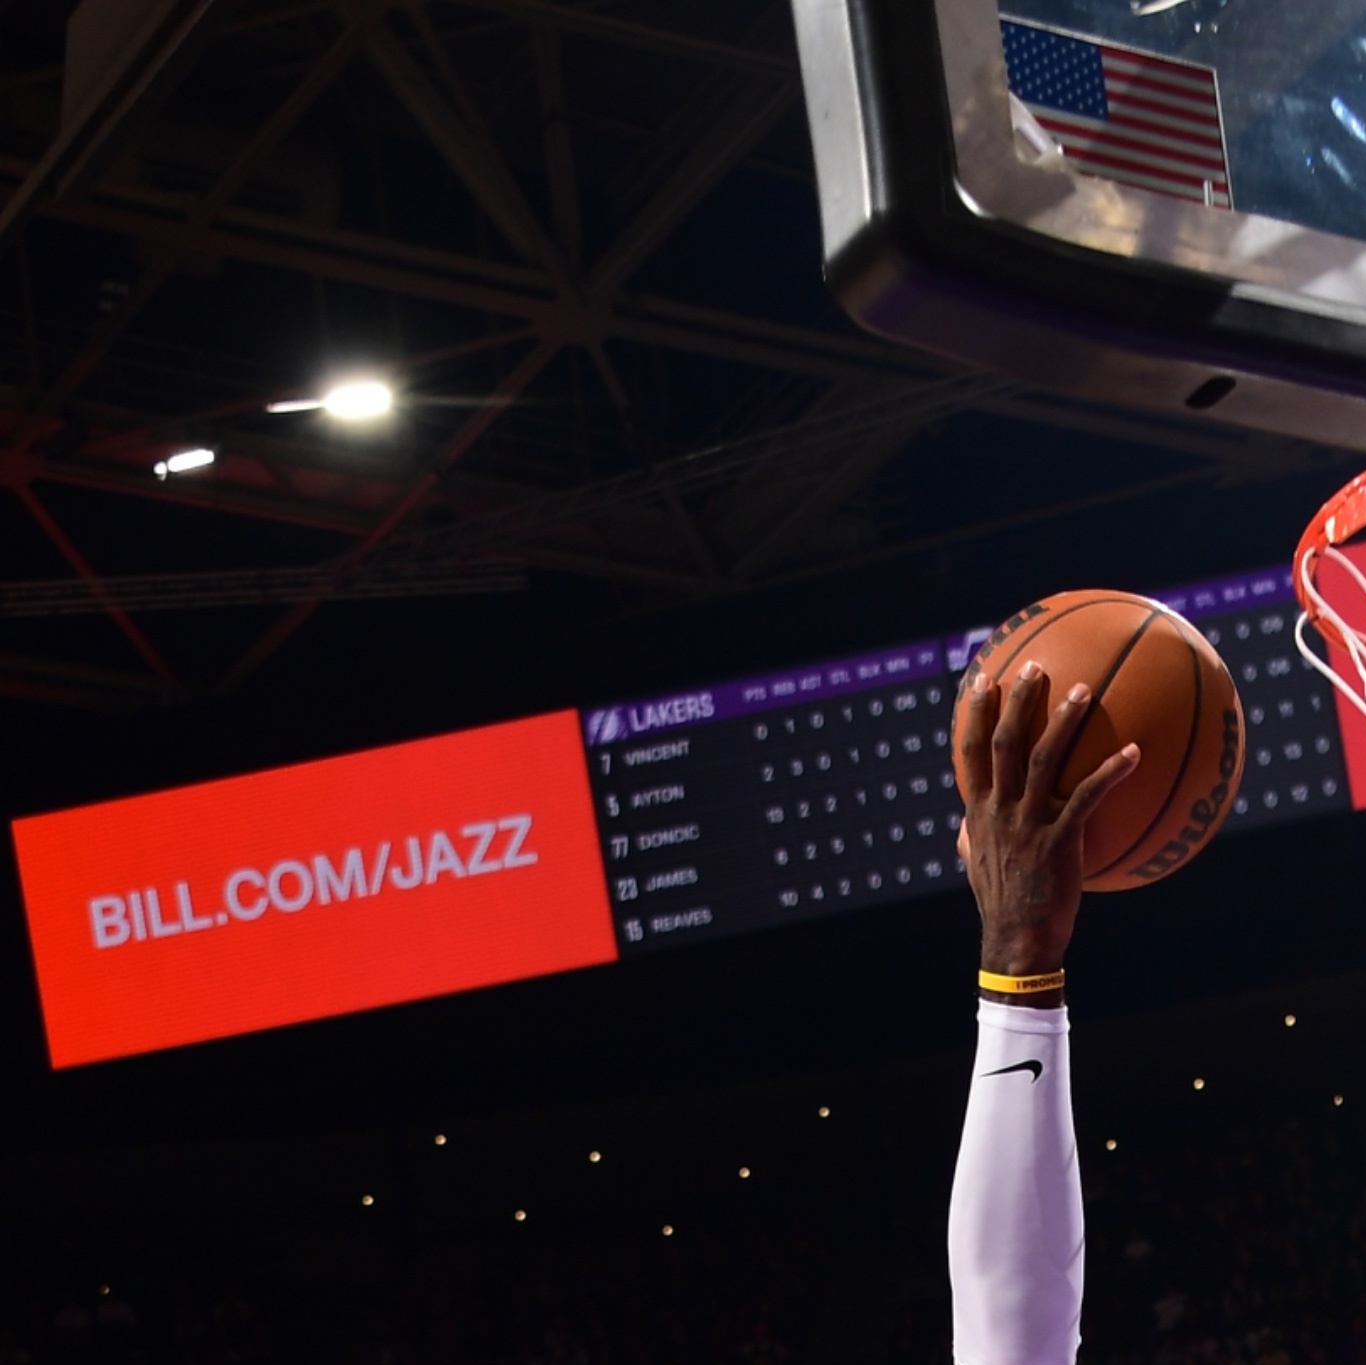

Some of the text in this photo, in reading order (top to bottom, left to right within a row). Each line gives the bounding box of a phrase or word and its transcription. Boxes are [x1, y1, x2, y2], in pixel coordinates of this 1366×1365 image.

[628, 691, 715, 732] LAKERS
[624, 740, 690, 766] VINCENT
[632, 785, 685, 808] AYTON
[88, 814, 538, 948] BILL.COM/JAZZ
[617, 877, 638, 901] 23
[645, 867, 699, 892] JAMES
[651, 908, 713, 934] REAVES
